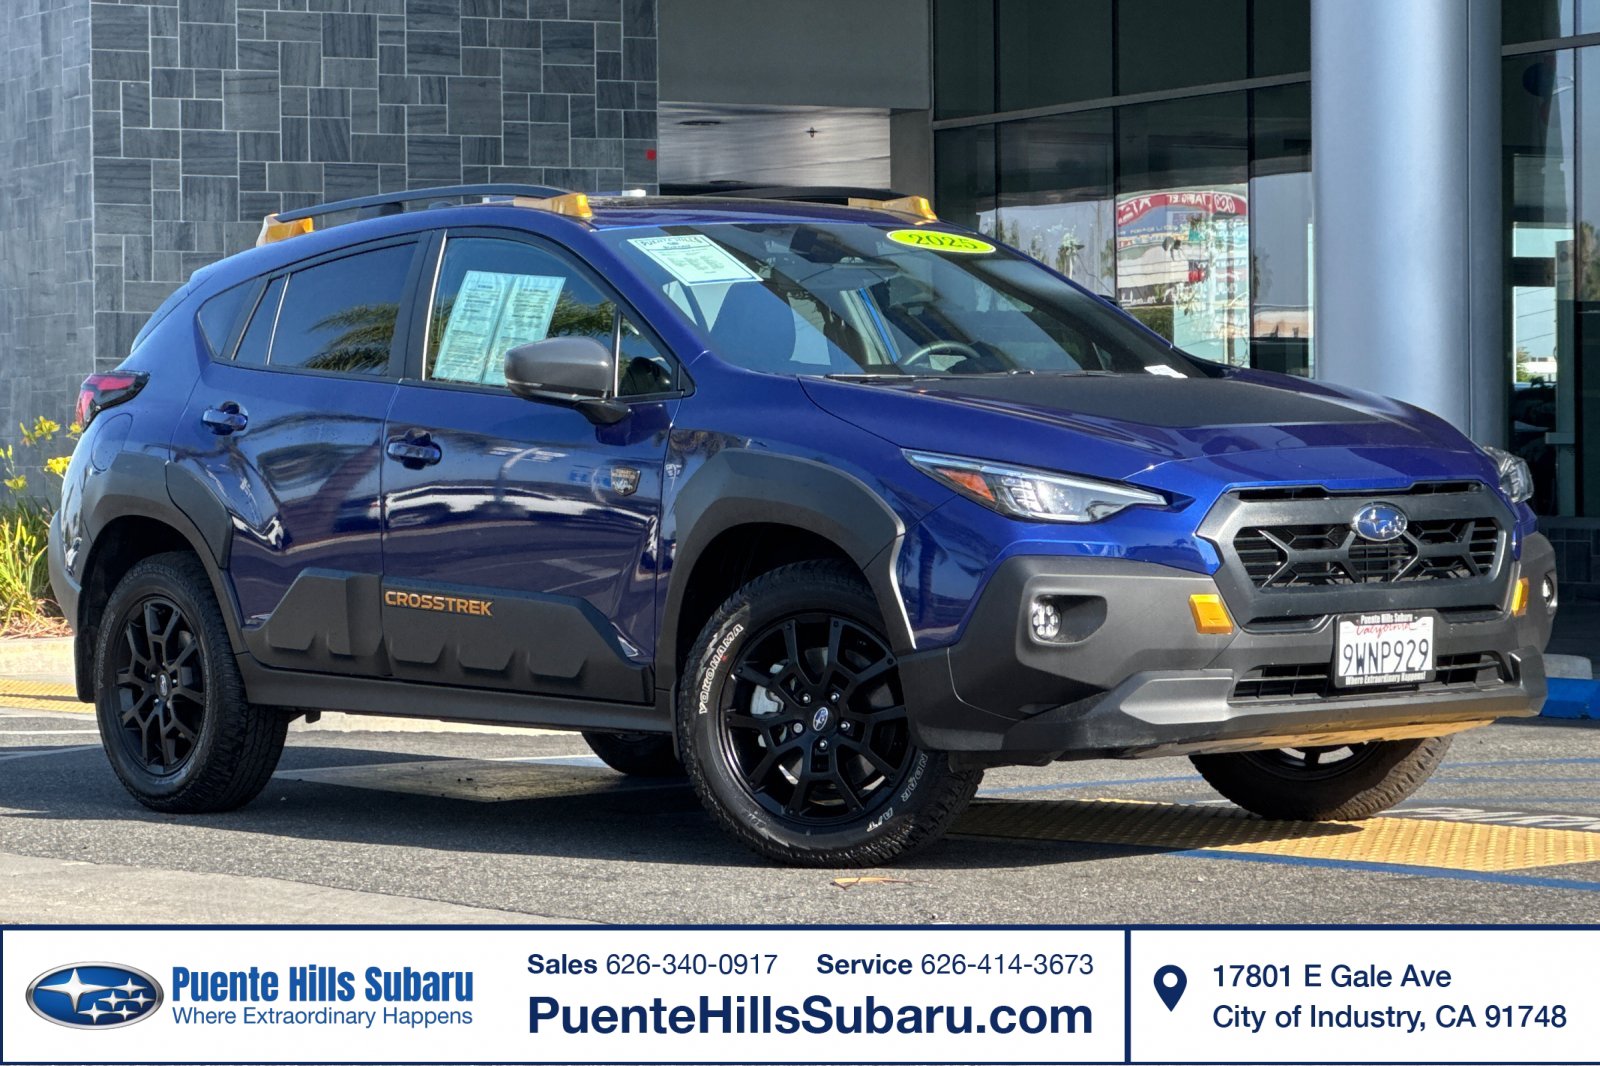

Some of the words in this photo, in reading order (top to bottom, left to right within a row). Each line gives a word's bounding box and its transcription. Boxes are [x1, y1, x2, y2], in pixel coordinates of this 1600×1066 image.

[908, 233, 978, 250] 2025
[384, 590, 494, 617] CROSSTREK
[1360, 614, 1381, 625] Puente
[1381, 613, 1394, 623] Hills
[1343, 638, 1429, 676] 9WNP929
[698, 623, 744, 715] YOKOHAMA
[1345, 675, 1364, 686] Where
